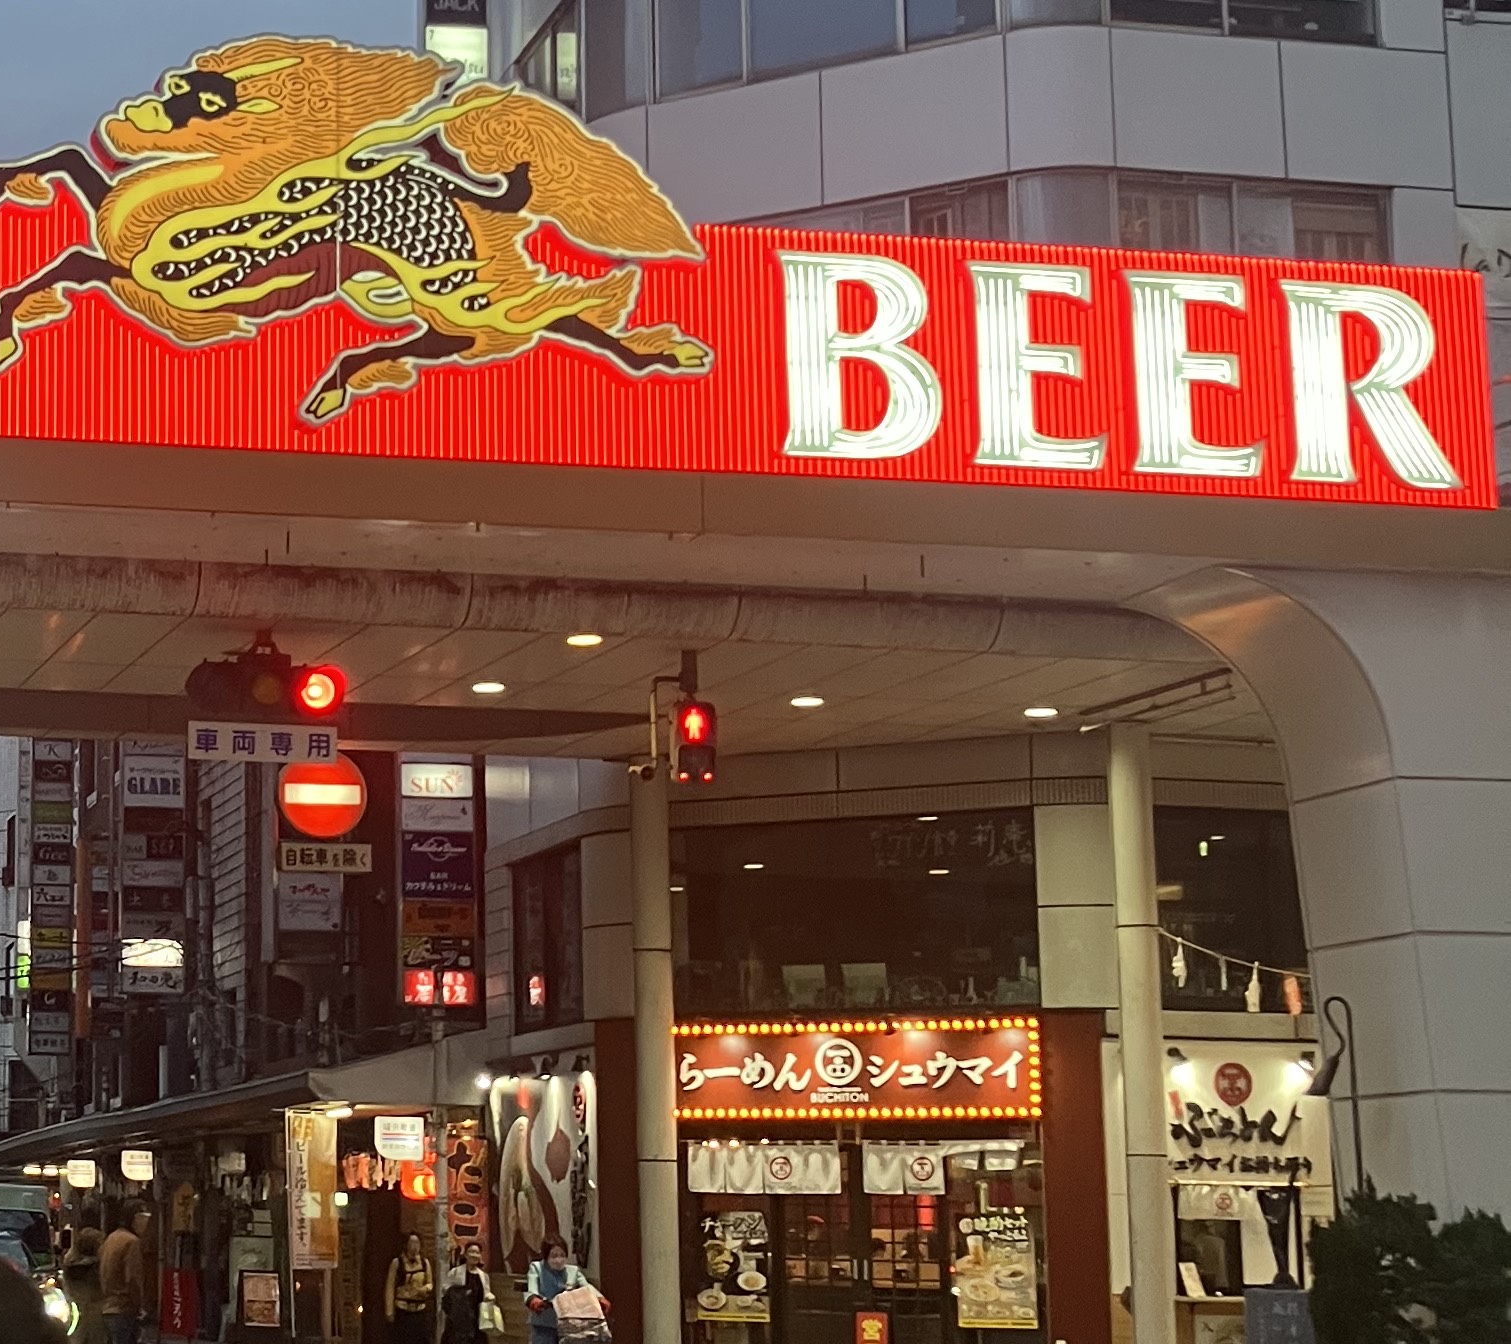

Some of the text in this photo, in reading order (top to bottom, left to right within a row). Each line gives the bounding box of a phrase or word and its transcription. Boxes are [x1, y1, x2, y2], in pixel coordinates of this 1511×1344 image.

[773, 250, 1465, 490] BEER
[194, 727, 331, 758] 車両専用
[410, 776, 455, 794] SUN
[285, 848, 367, 867] 自転車を除く
[678, 1050, 1024, 1092] らーめん シュウマイ
